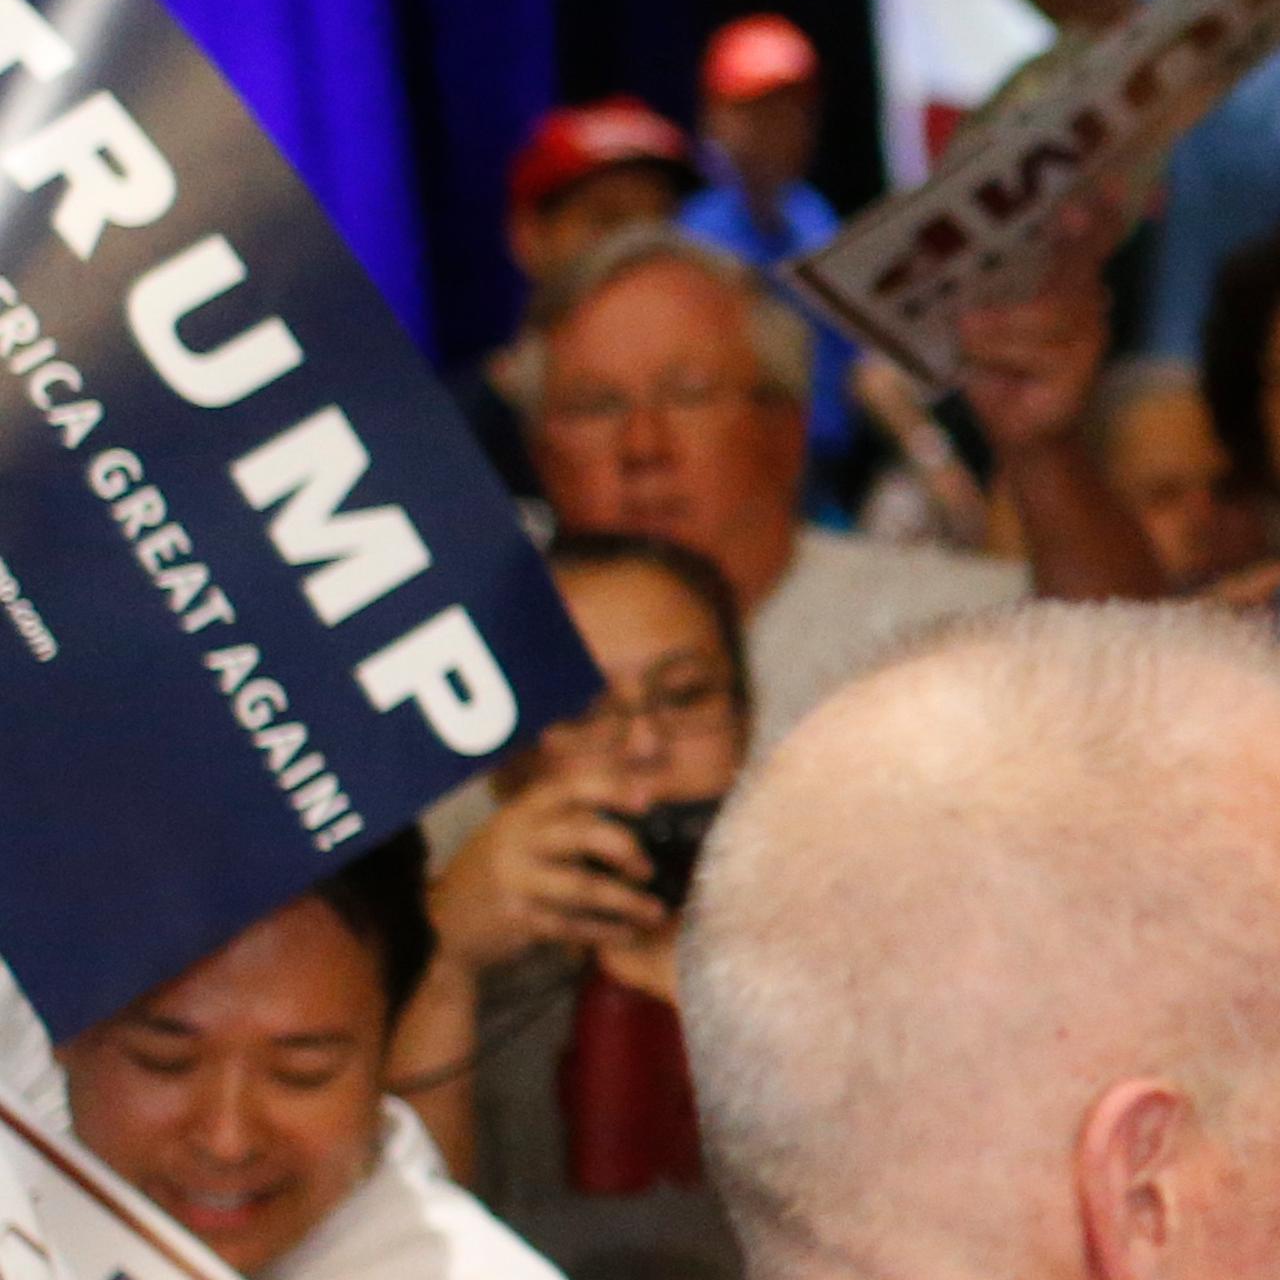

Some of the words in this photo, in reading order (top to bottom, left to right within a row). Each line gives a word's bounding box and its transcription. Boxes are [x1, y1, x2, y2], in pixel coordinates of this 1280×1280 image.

[0, 274, 104, 449] RICA
[86, 448, 237, 634] GREAT
[205, 642, 365, 853] AGAIN!
